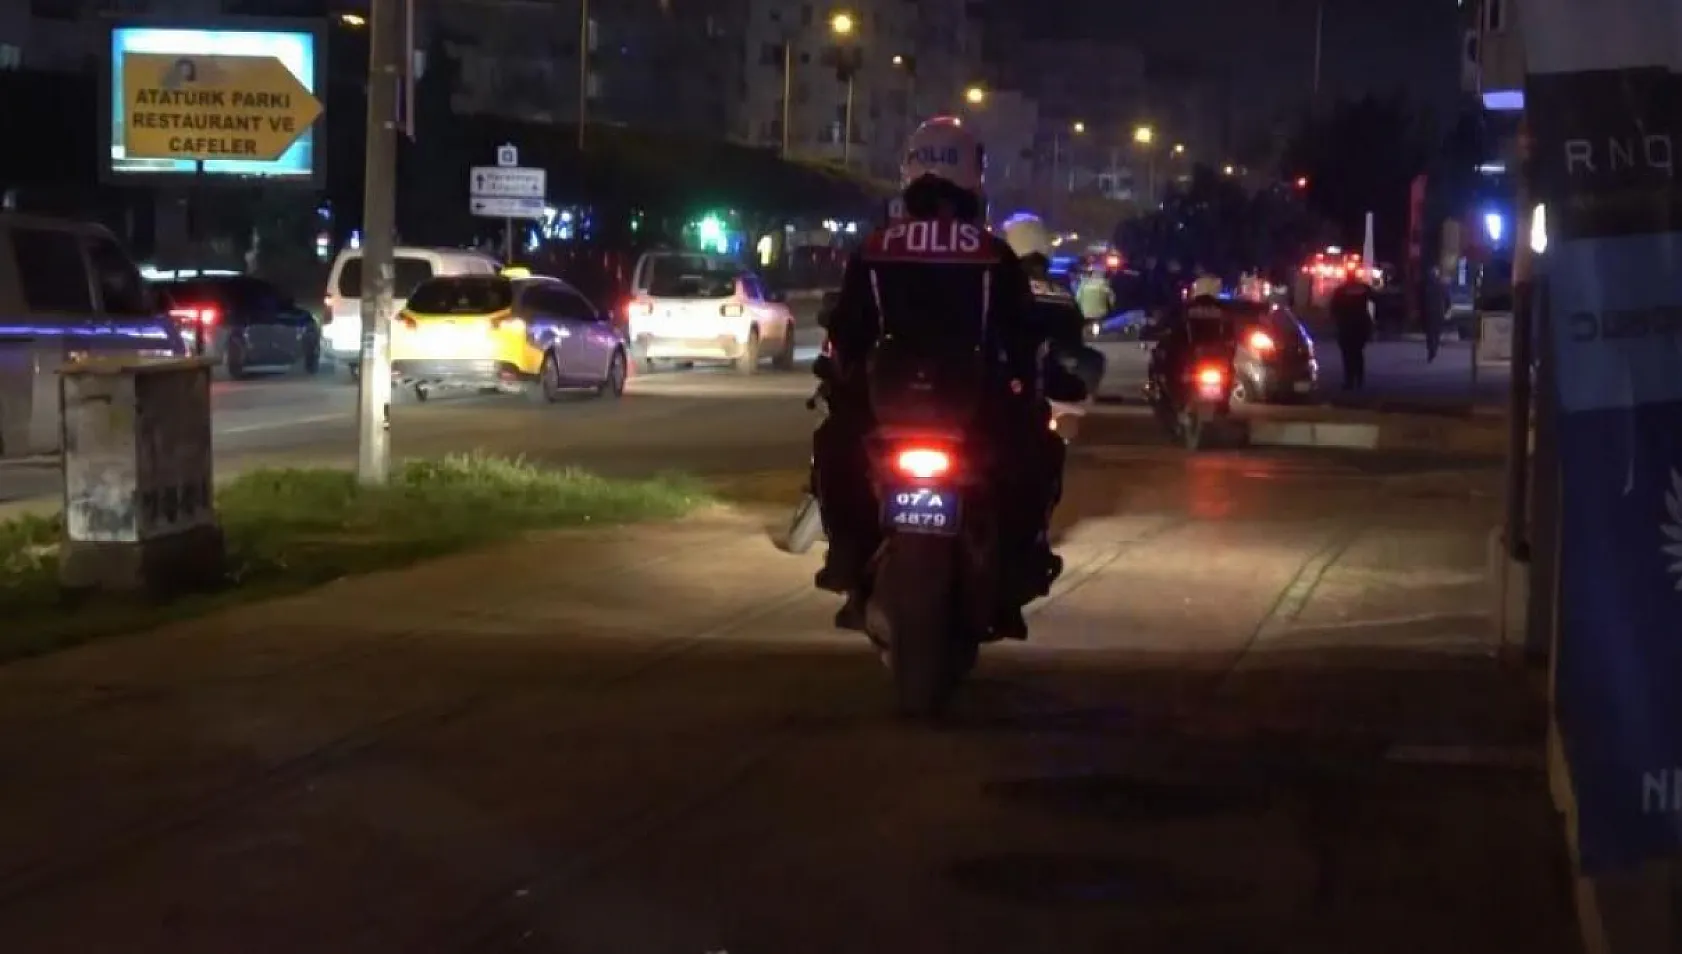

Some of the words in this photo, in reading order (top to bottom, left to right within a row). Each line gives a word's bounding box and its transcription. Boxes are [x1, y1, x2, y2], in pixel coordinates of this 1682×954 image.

[232, 92, 291, 109] PARKI
[132, 112, 264, 132] RESTAURANT
[268, 116, 296, 133] VE
[168, 136, 257, 155] CAFELER
[882, 219, 981, 253] POLIS
[896, 493, 921, 506] 07
[927, 494, 943, 508] A
[893, 512, 947, 527] 4879
